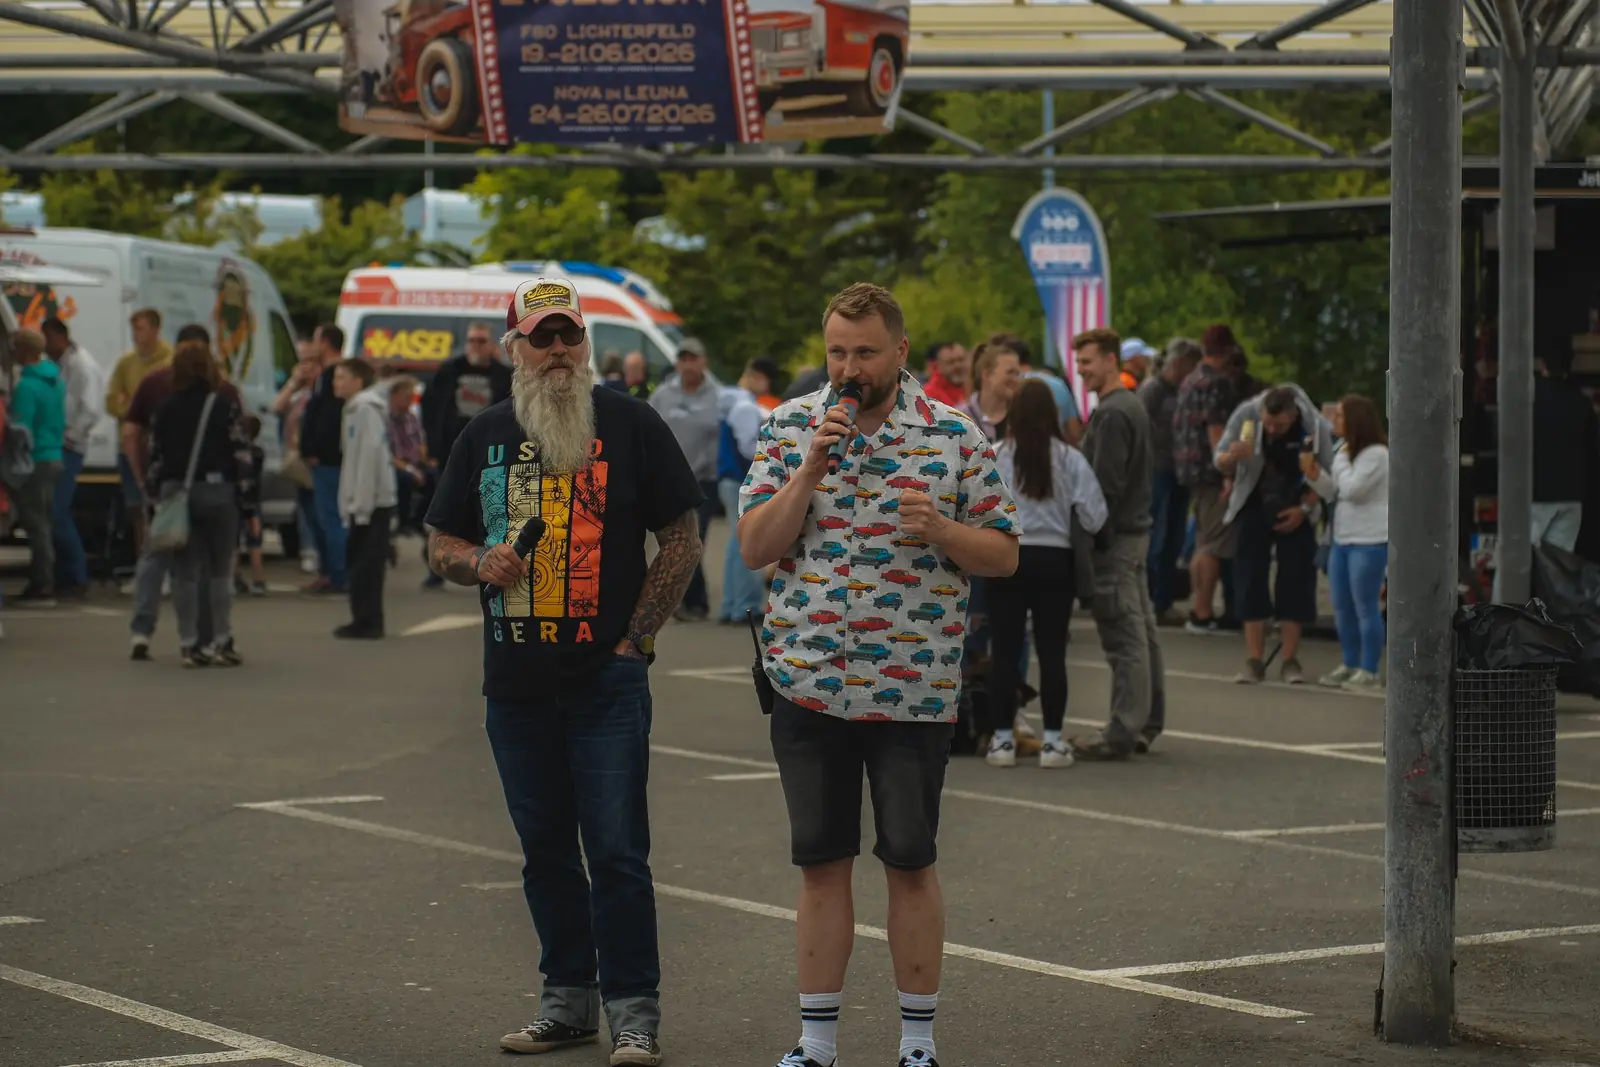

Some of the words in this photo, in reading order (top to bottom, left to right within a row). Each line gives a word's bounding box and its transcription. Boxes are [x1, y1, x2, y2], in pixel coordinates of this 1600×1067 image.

[566, 23, 696, 39] LICHTERFELD
[554, 85, 602, 101] NOVA
[624, 85, 689, 101] LEUNA
[526, 283, 569, 299] Stetson
[386, 329, 454, 360] ASB
[493, 620, 594, 644] GERA
